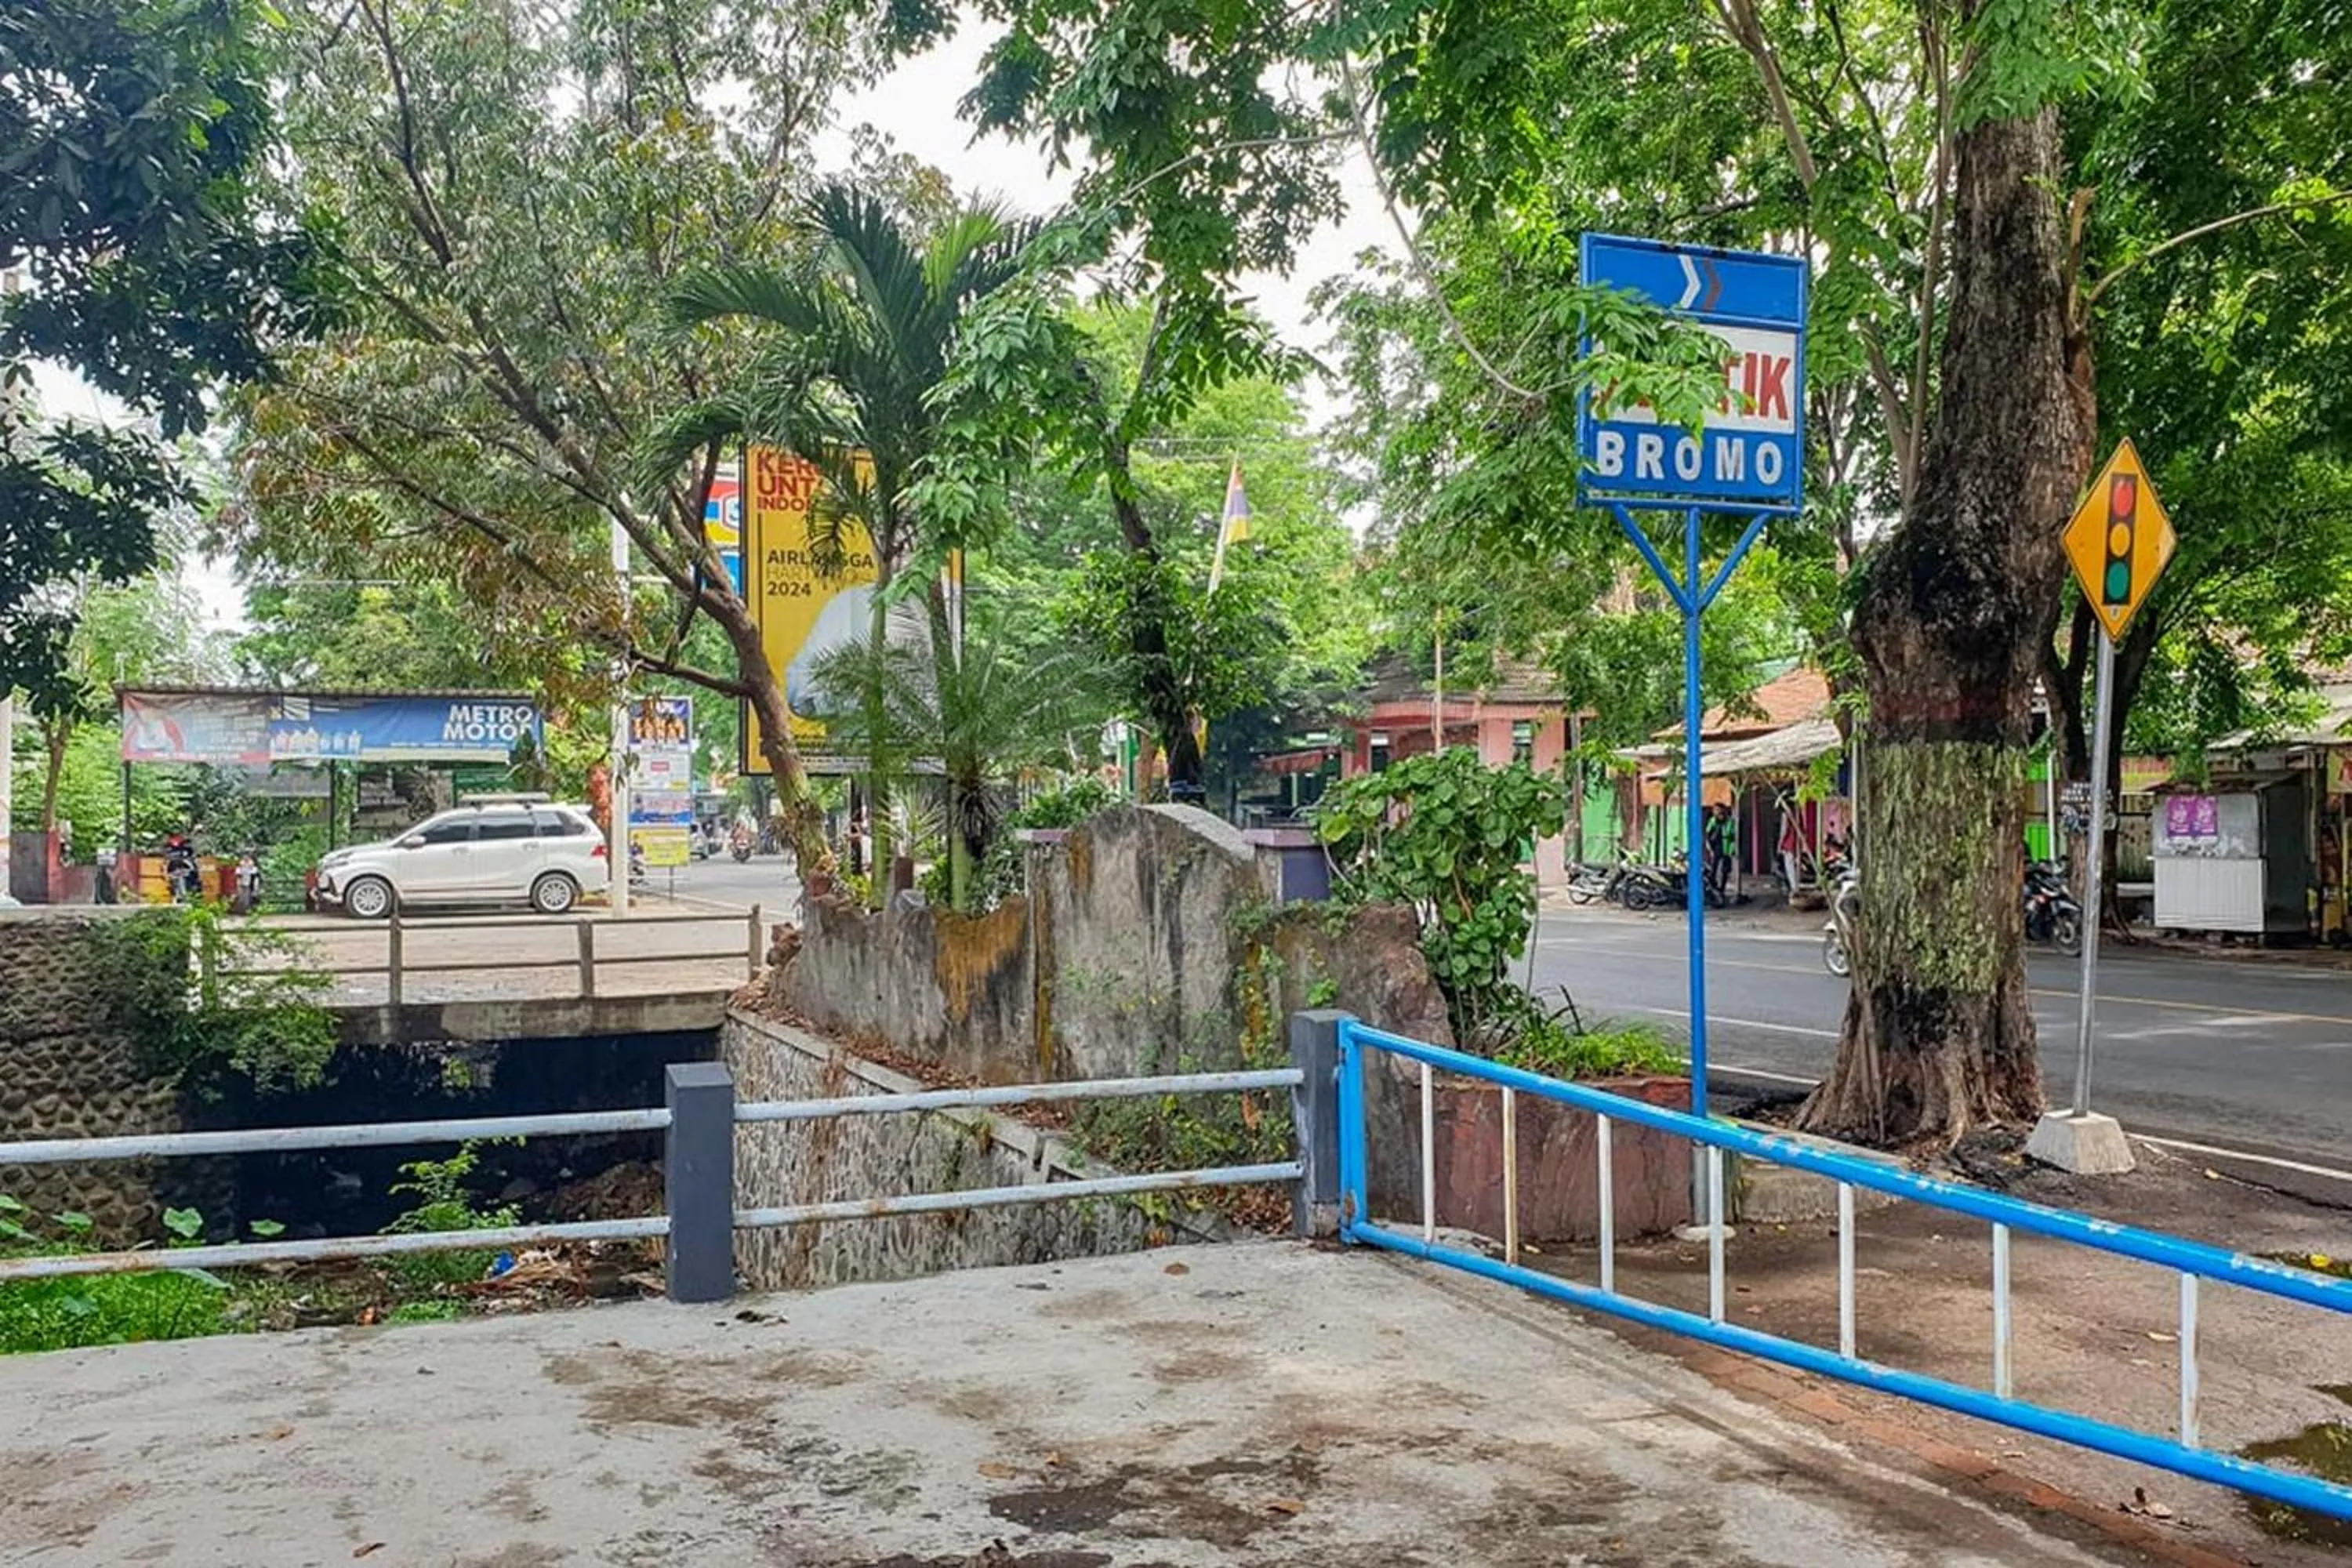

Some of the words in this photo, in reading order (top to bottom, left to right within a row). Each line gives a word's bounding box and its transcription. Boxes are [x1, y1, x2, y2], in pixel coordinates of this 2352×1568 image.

[757, 450, 818, 476] KER
[1596, 430, 1783, 485] BROMO
[757, 474, 816, 497] UNT
[757, 496, 811, 511] INDO
[767, 550, 874, 569] AIRLGA
[767, 580, 811, 598] 2024
[449, 705, 533, 723] METRO
